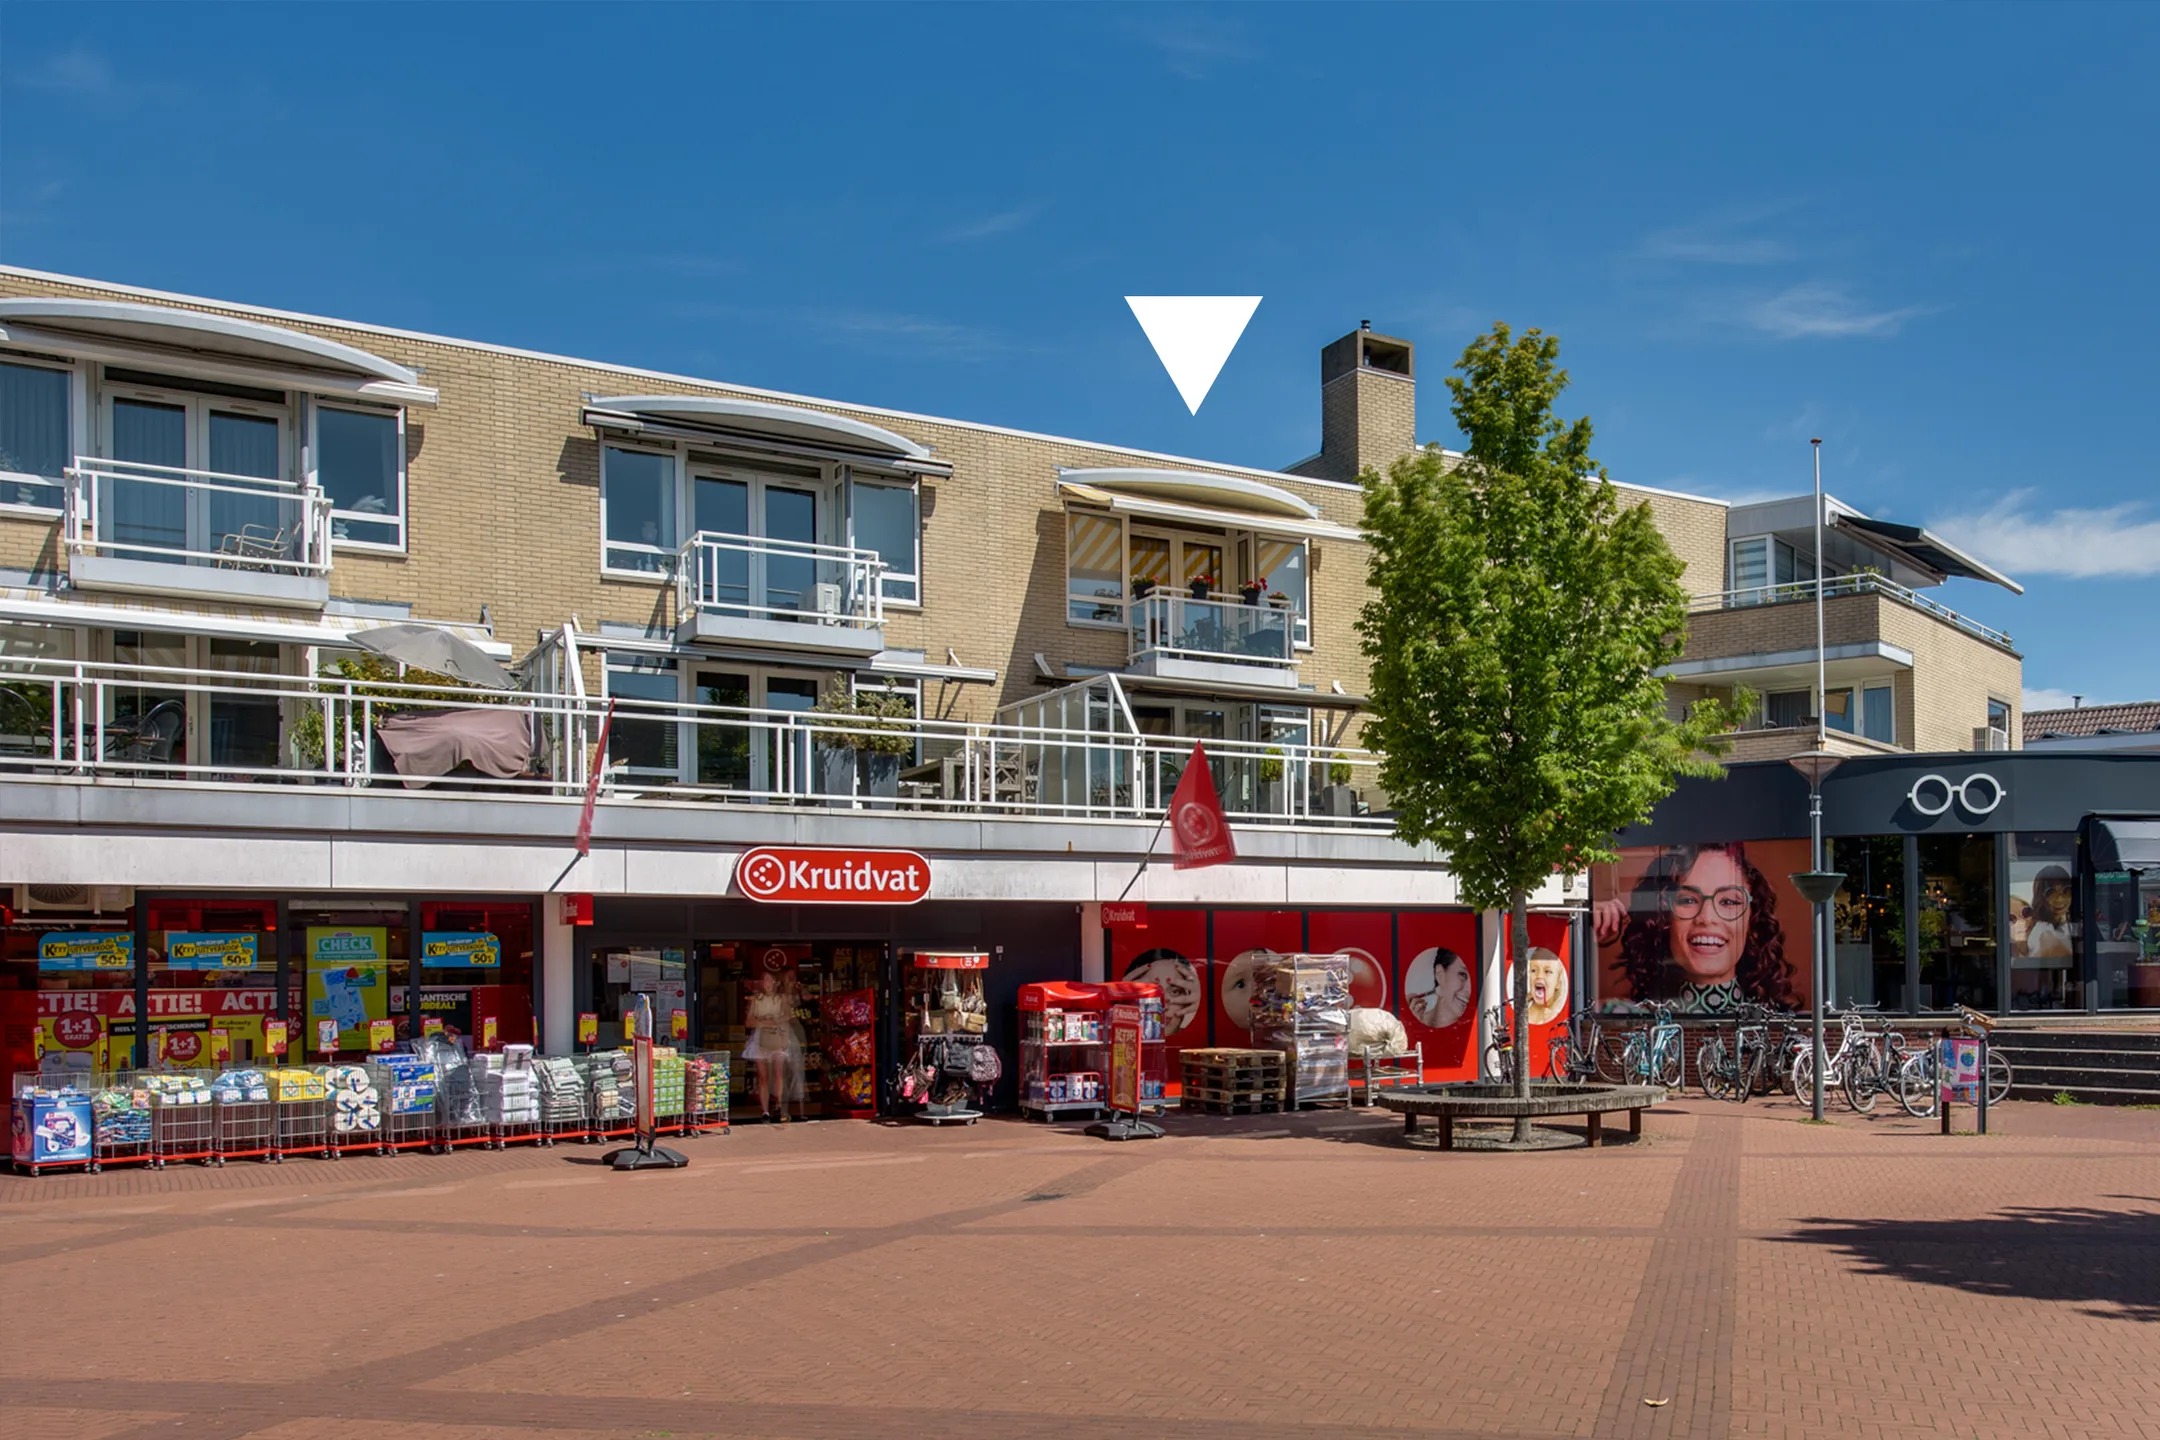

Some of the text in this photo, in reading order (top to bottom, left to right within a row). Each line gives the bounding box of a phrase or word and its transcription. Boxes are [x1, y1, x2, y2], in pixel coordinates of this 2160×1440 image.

[789, 860, 920, 891] Kruidvat
[320, 938, 370, 950] CHECK
[38, 993, 98, 1012] TIE!
[118, 993, 202, 1013] ATIE!
[221, 991, 302, 1010] ACTI!
[61, 1018, 93, 1034] 1+1
[170, 1036, 196, 1050] 1+1
